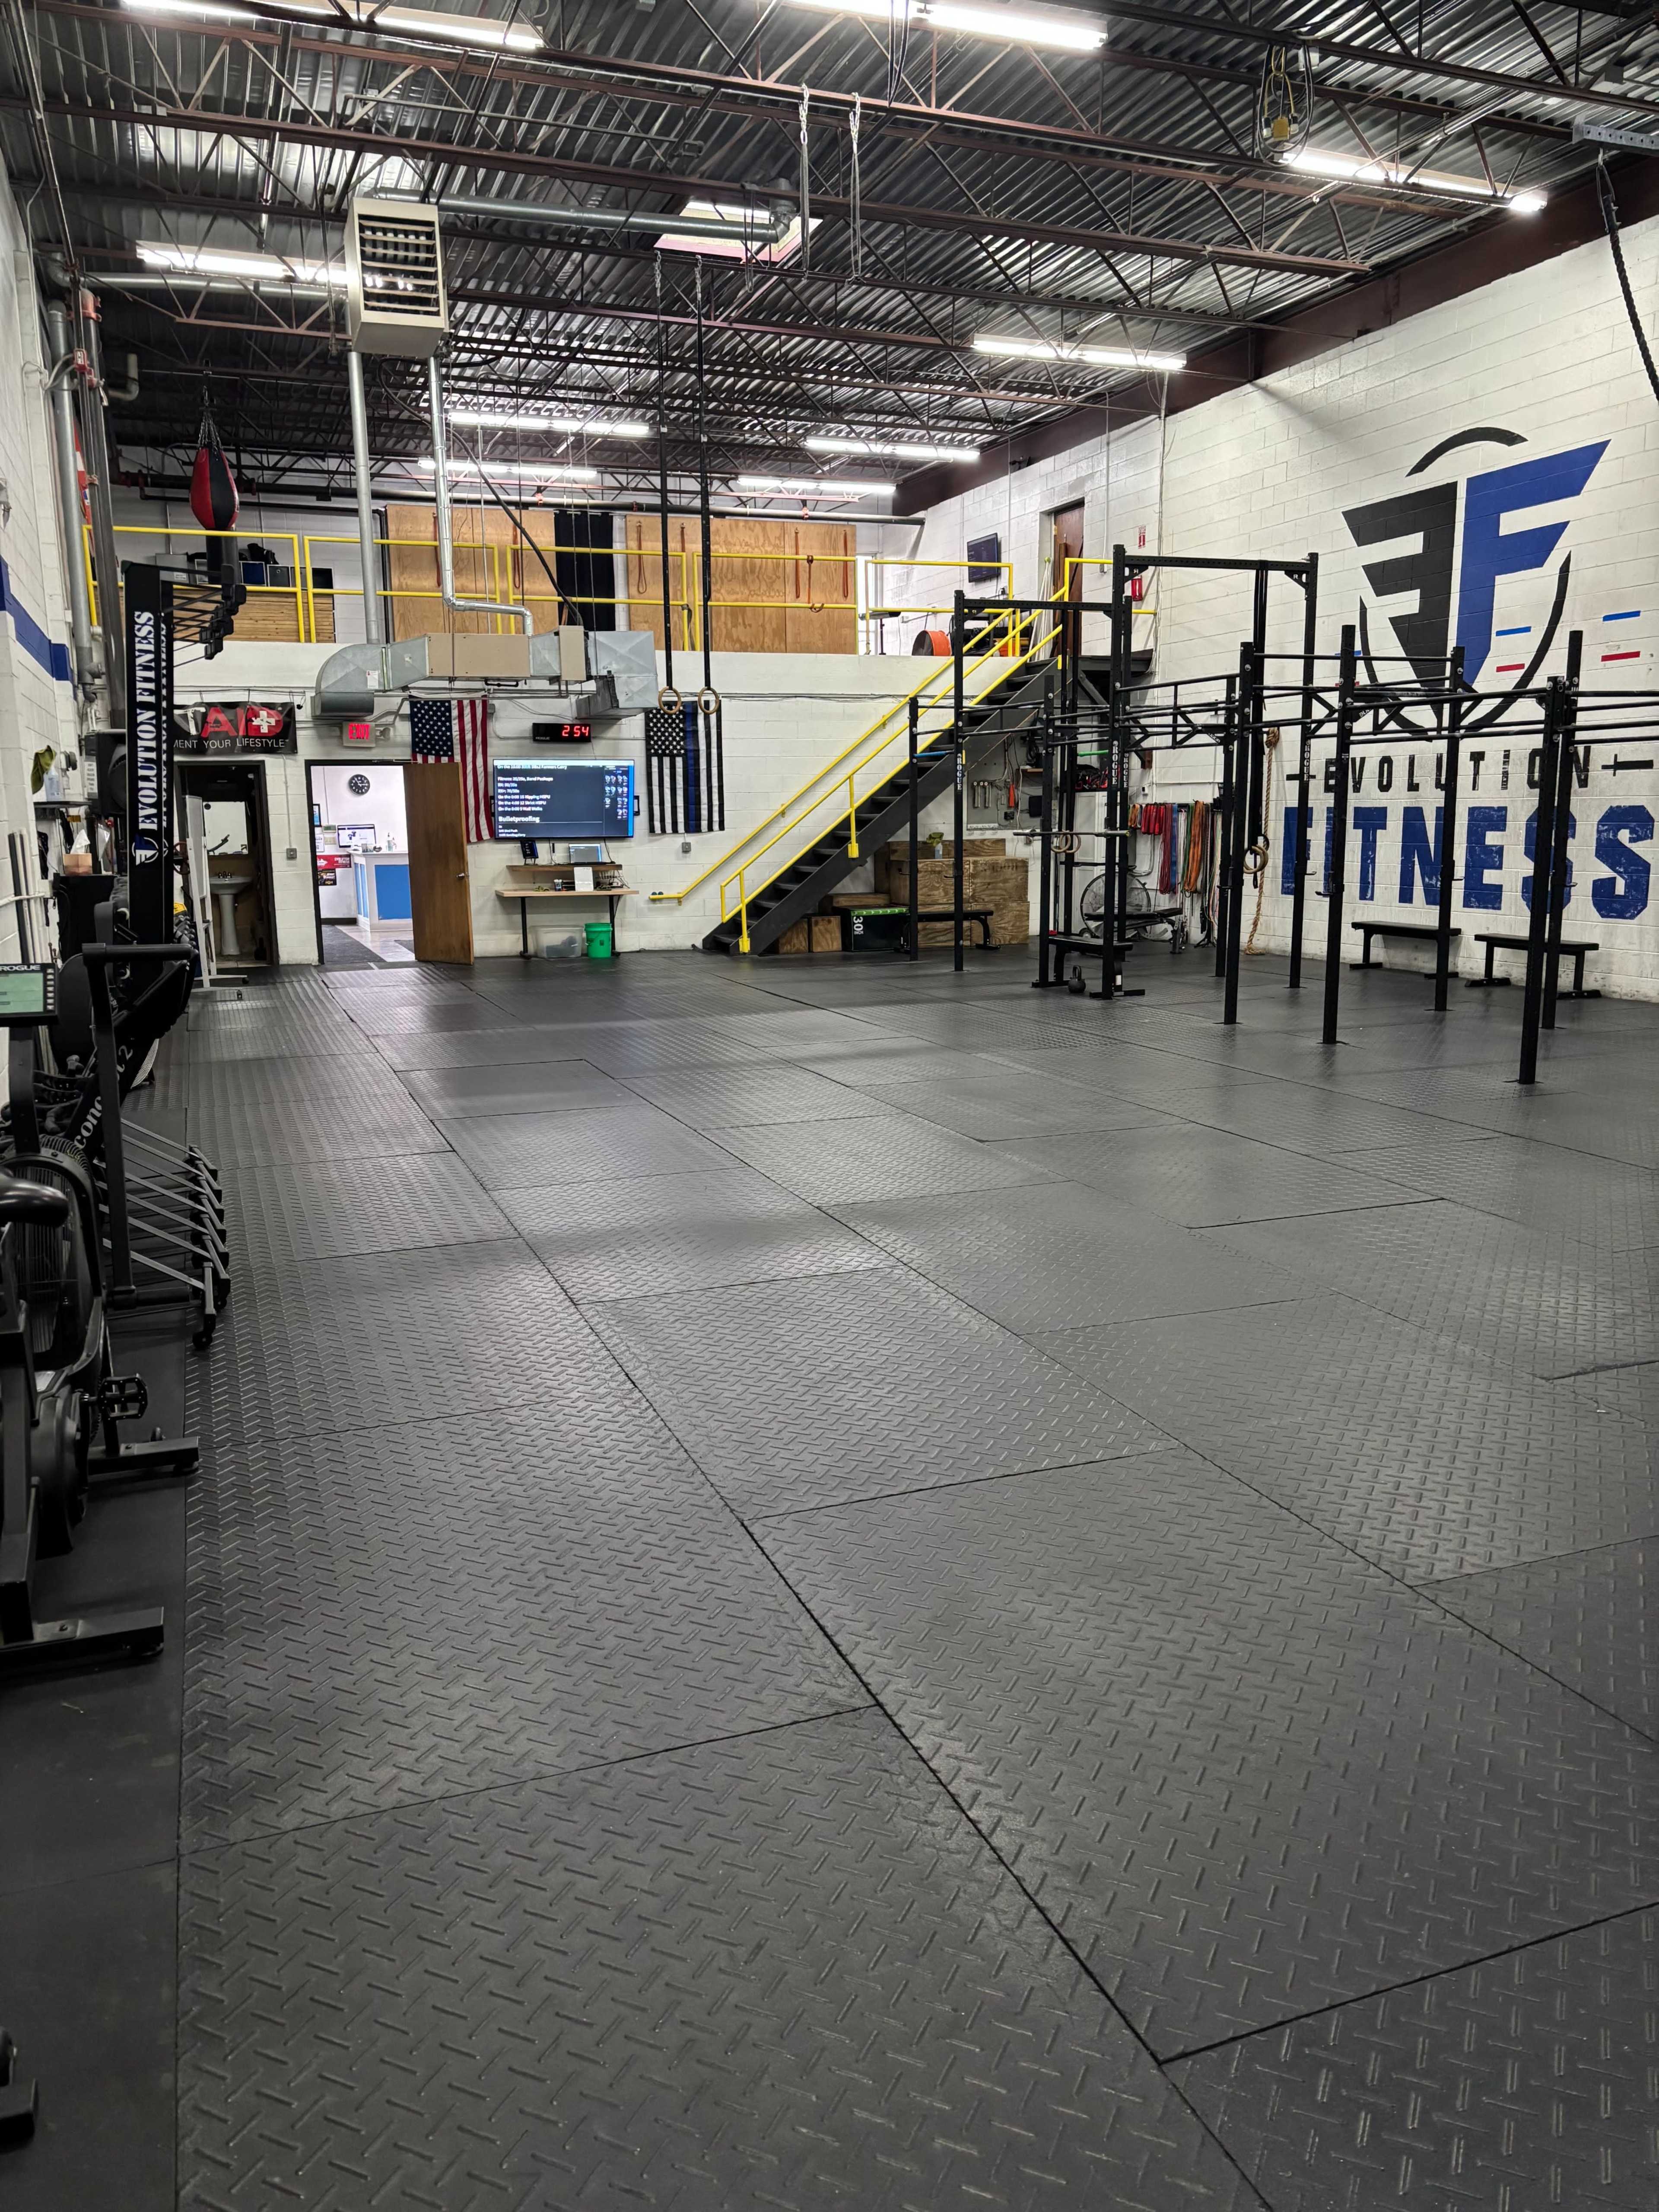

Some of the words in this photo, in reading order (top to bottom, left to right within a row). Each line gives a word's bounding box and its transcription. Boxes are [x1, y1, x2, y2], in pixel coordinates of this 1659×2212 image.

[134, 611, 156, 703] FITNESS
[349, 724, 369, 739] EXIT
[203, 739, 231, 748] YOUR
[237, 738, 285, 748] LIFESTYLE
[137, 708, 157, 831] EVOLUTION
[853, 917, 863, 931] 30
[118, 1045, 133, 1060] 2
